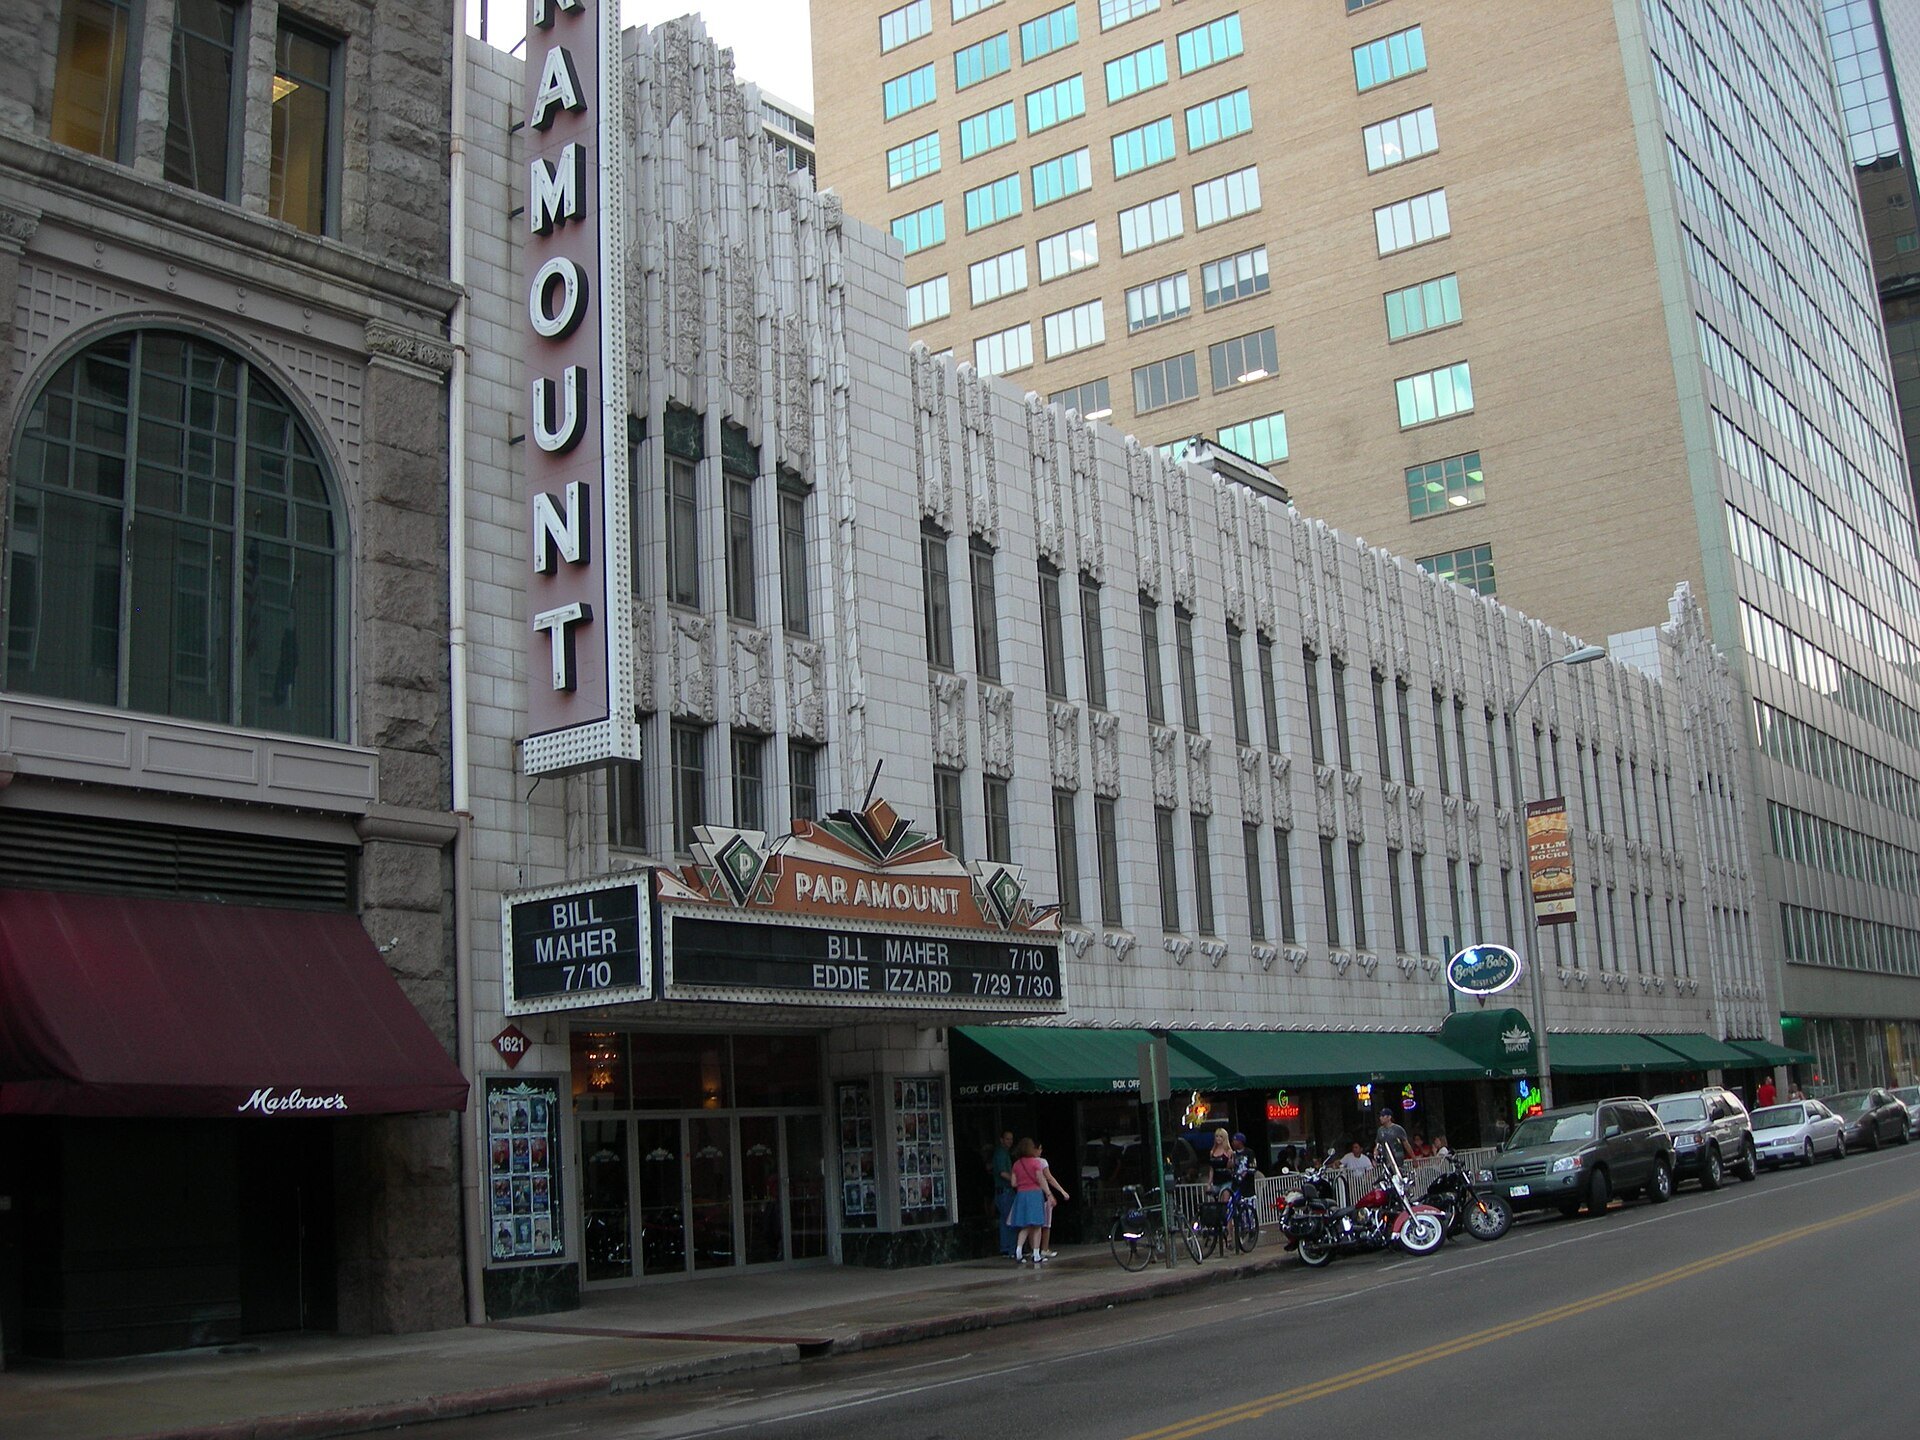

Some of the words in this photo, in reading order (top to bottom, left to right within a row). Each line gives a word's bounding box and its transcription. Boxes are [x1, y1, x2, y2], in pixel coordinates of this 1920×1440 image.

[1530, 851, 1569, 861] ROCKS
[1531, 840, 1566, 851] FILM
[795, 872, 960, 915] PARAMOUNT
[552, 899, 603, 929] BILL
[535, 928, 617, 964] MAHER
[886, 943, 949, 965] MAHER
[1009, 949, 1044, 971] 7/10
[563, 961, 612, 991] 7/10
[813, 964, 870, 990] EDDIE
[885, 968, 951, 994] IZZARD
[972, 973, 1011, 995] 7/29
[1015, 975, 1054, 997] 7/30
[498, 1036, 524, 1052] 1621
[960, 1086, 978, 1095] BOX
[984, 1081, 1019, 1093] OFFICE
[1113, 1080, 1126, 1089] BOX
[1128, 1080, 1140, 1088] OFF
[238, 1087, 348, 1115] Marlowe's
